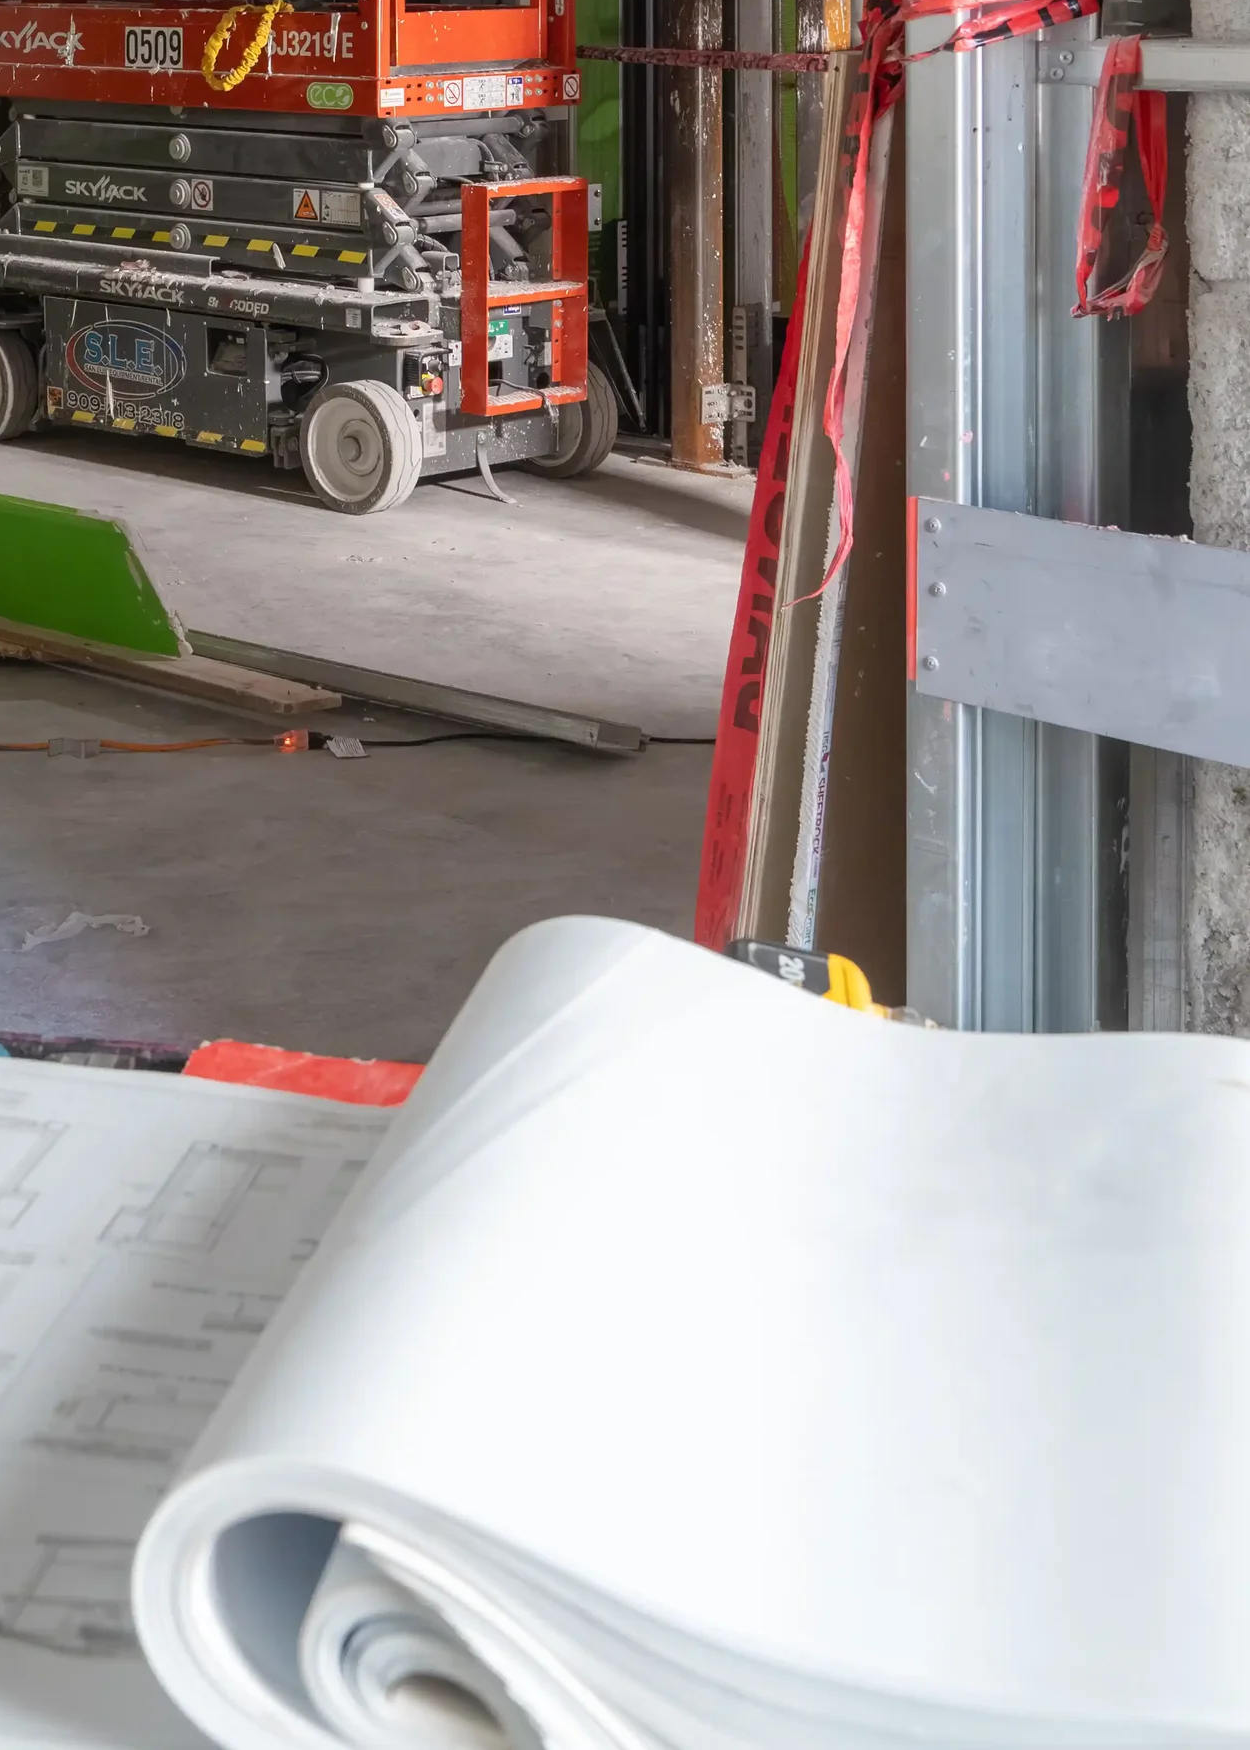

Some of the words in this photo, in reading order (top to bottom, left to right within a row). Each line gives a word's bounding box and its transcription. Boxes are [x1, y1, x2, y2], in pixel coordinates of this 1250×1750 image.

[125, 29, 182, 66] 0509
[65, 174, 148, 203] SKYJACK
[100, 279, 185, 305] SKYJACK
